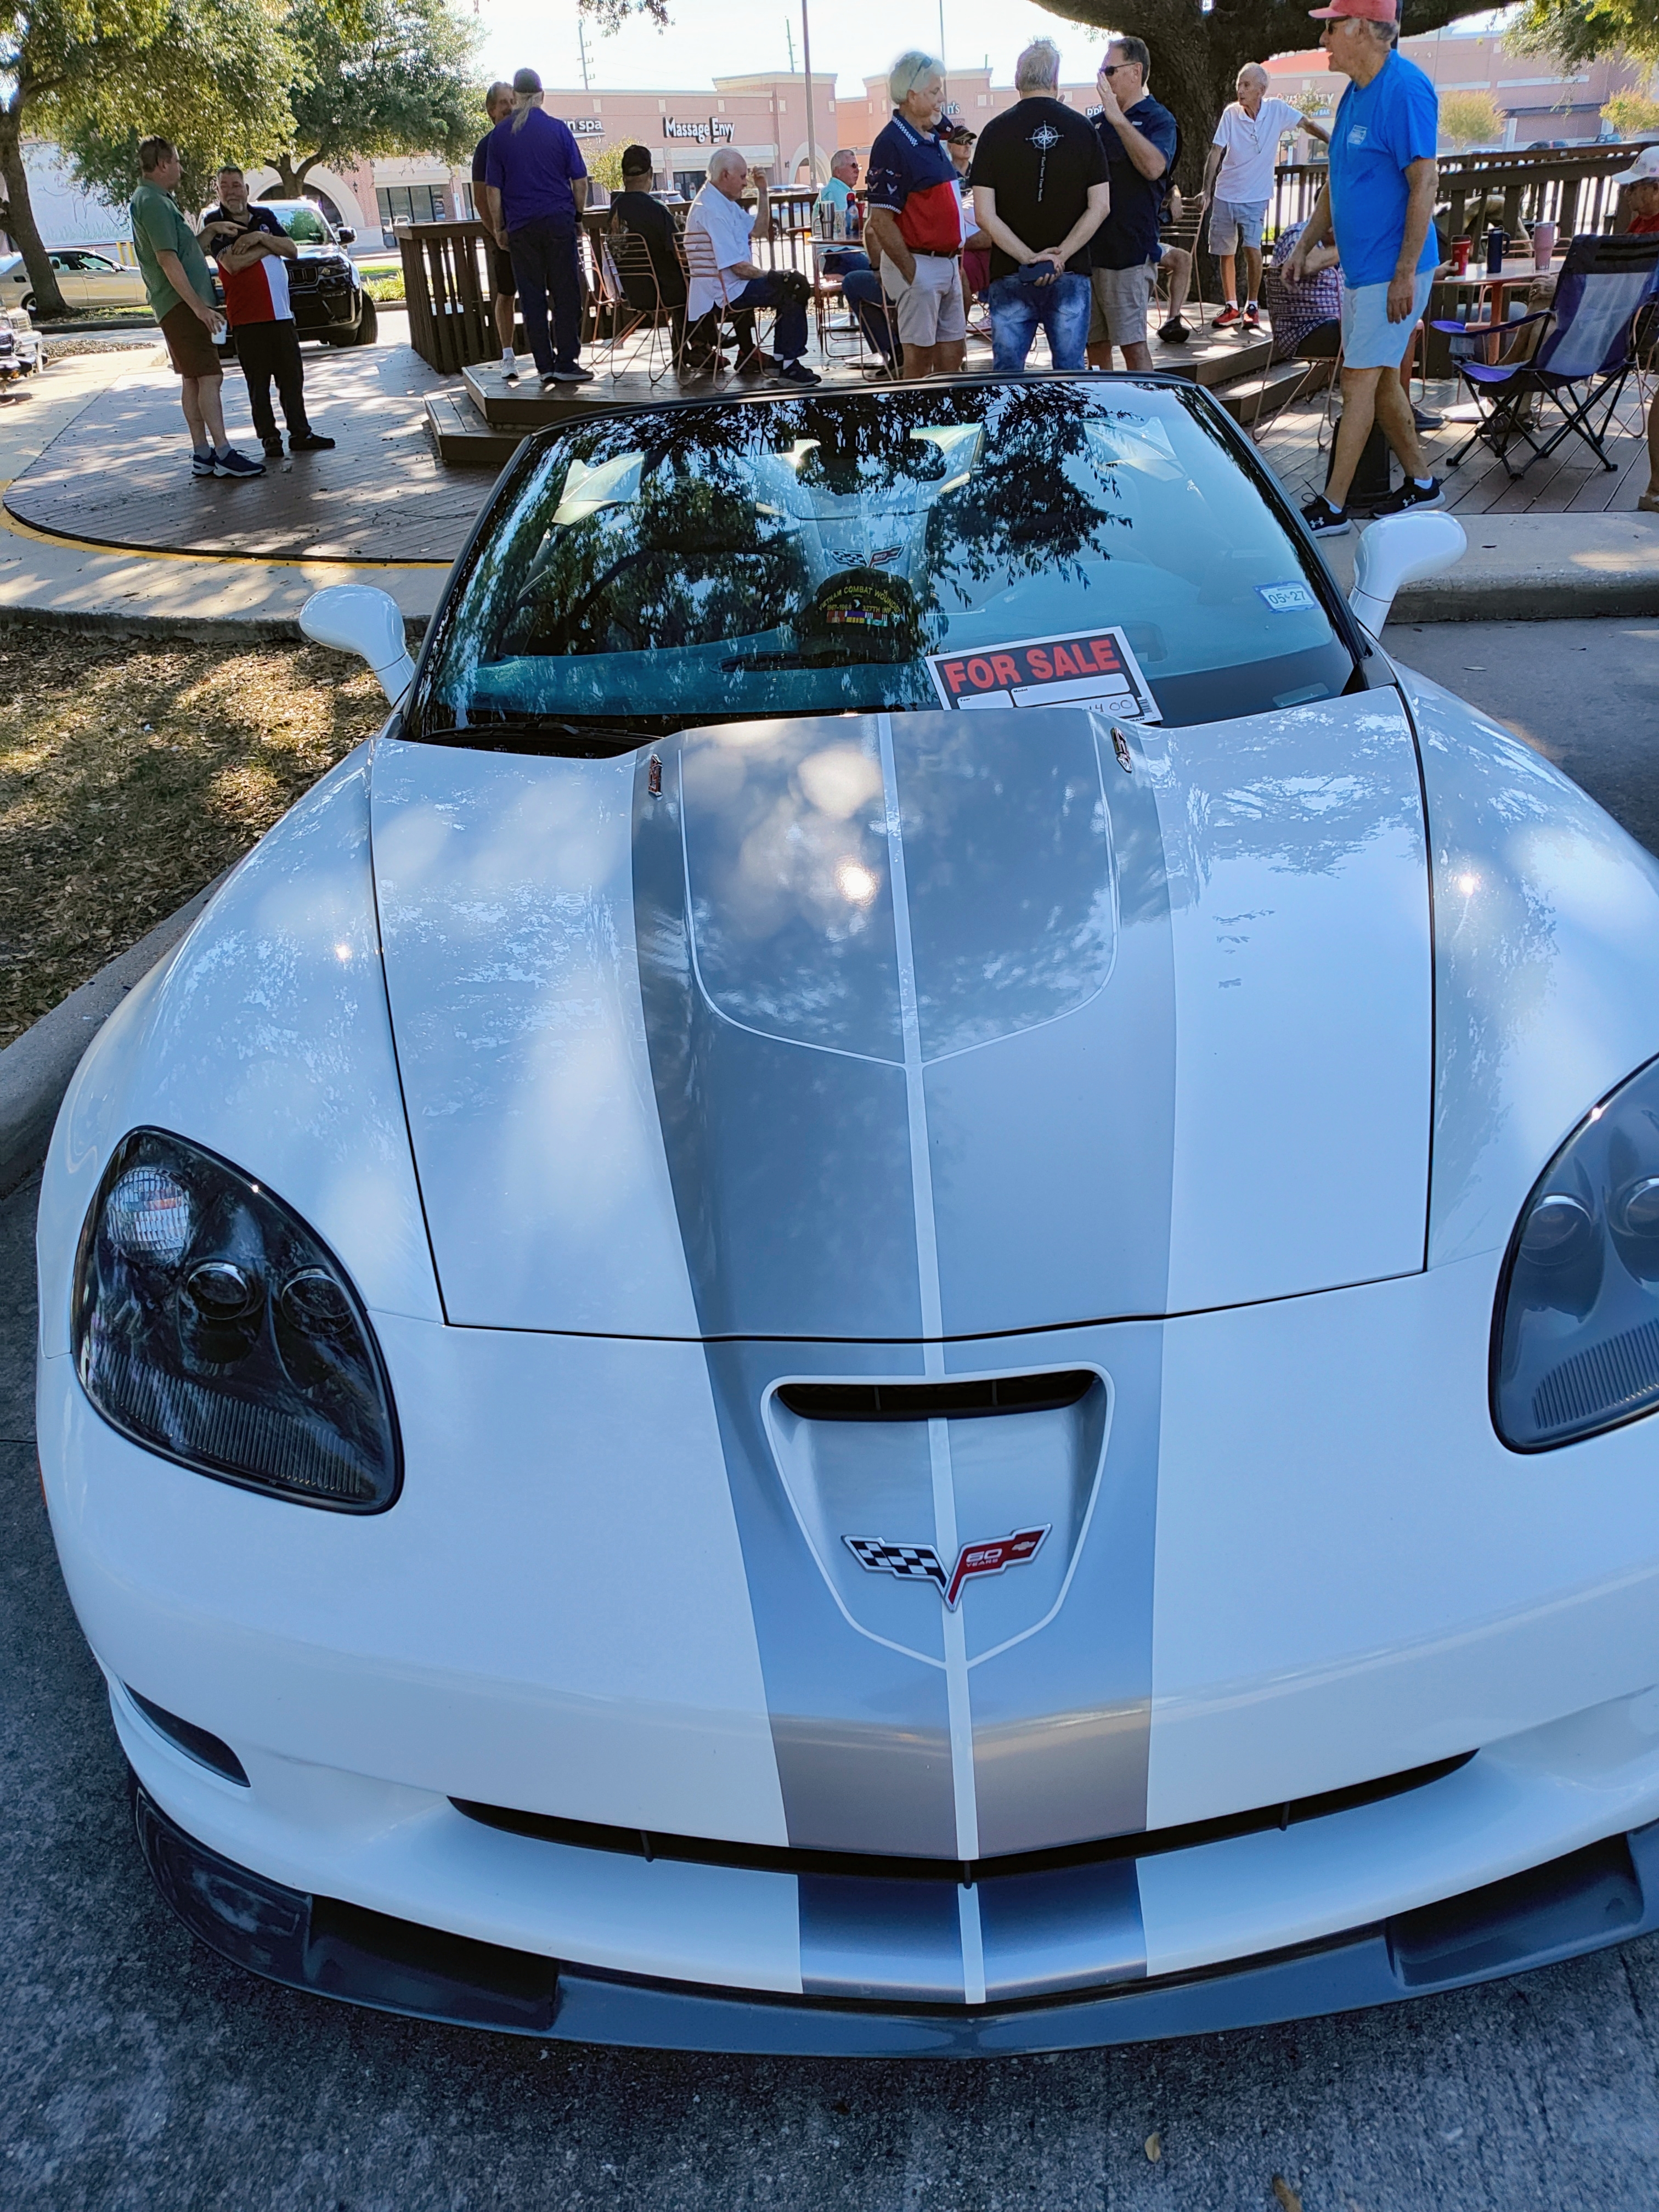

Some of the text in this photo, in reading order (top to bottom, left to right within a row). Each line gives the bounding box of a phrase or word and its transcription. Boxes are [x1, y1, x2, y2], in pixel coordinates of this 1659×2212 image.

[579, 120, 603, 132] spa
[663, 117, 735, 143] Massage Envy
[819, 589, 842, 611] VIETNAM
[844, 585, 873, 594] COMBAT
[1268, 591, 1306, 604] 05 27
[943, 639, 1121, 693] FOR SALE
[966, 1548, 1002, 1562] 60
[966, 1558, 998, 1568] YEARS
